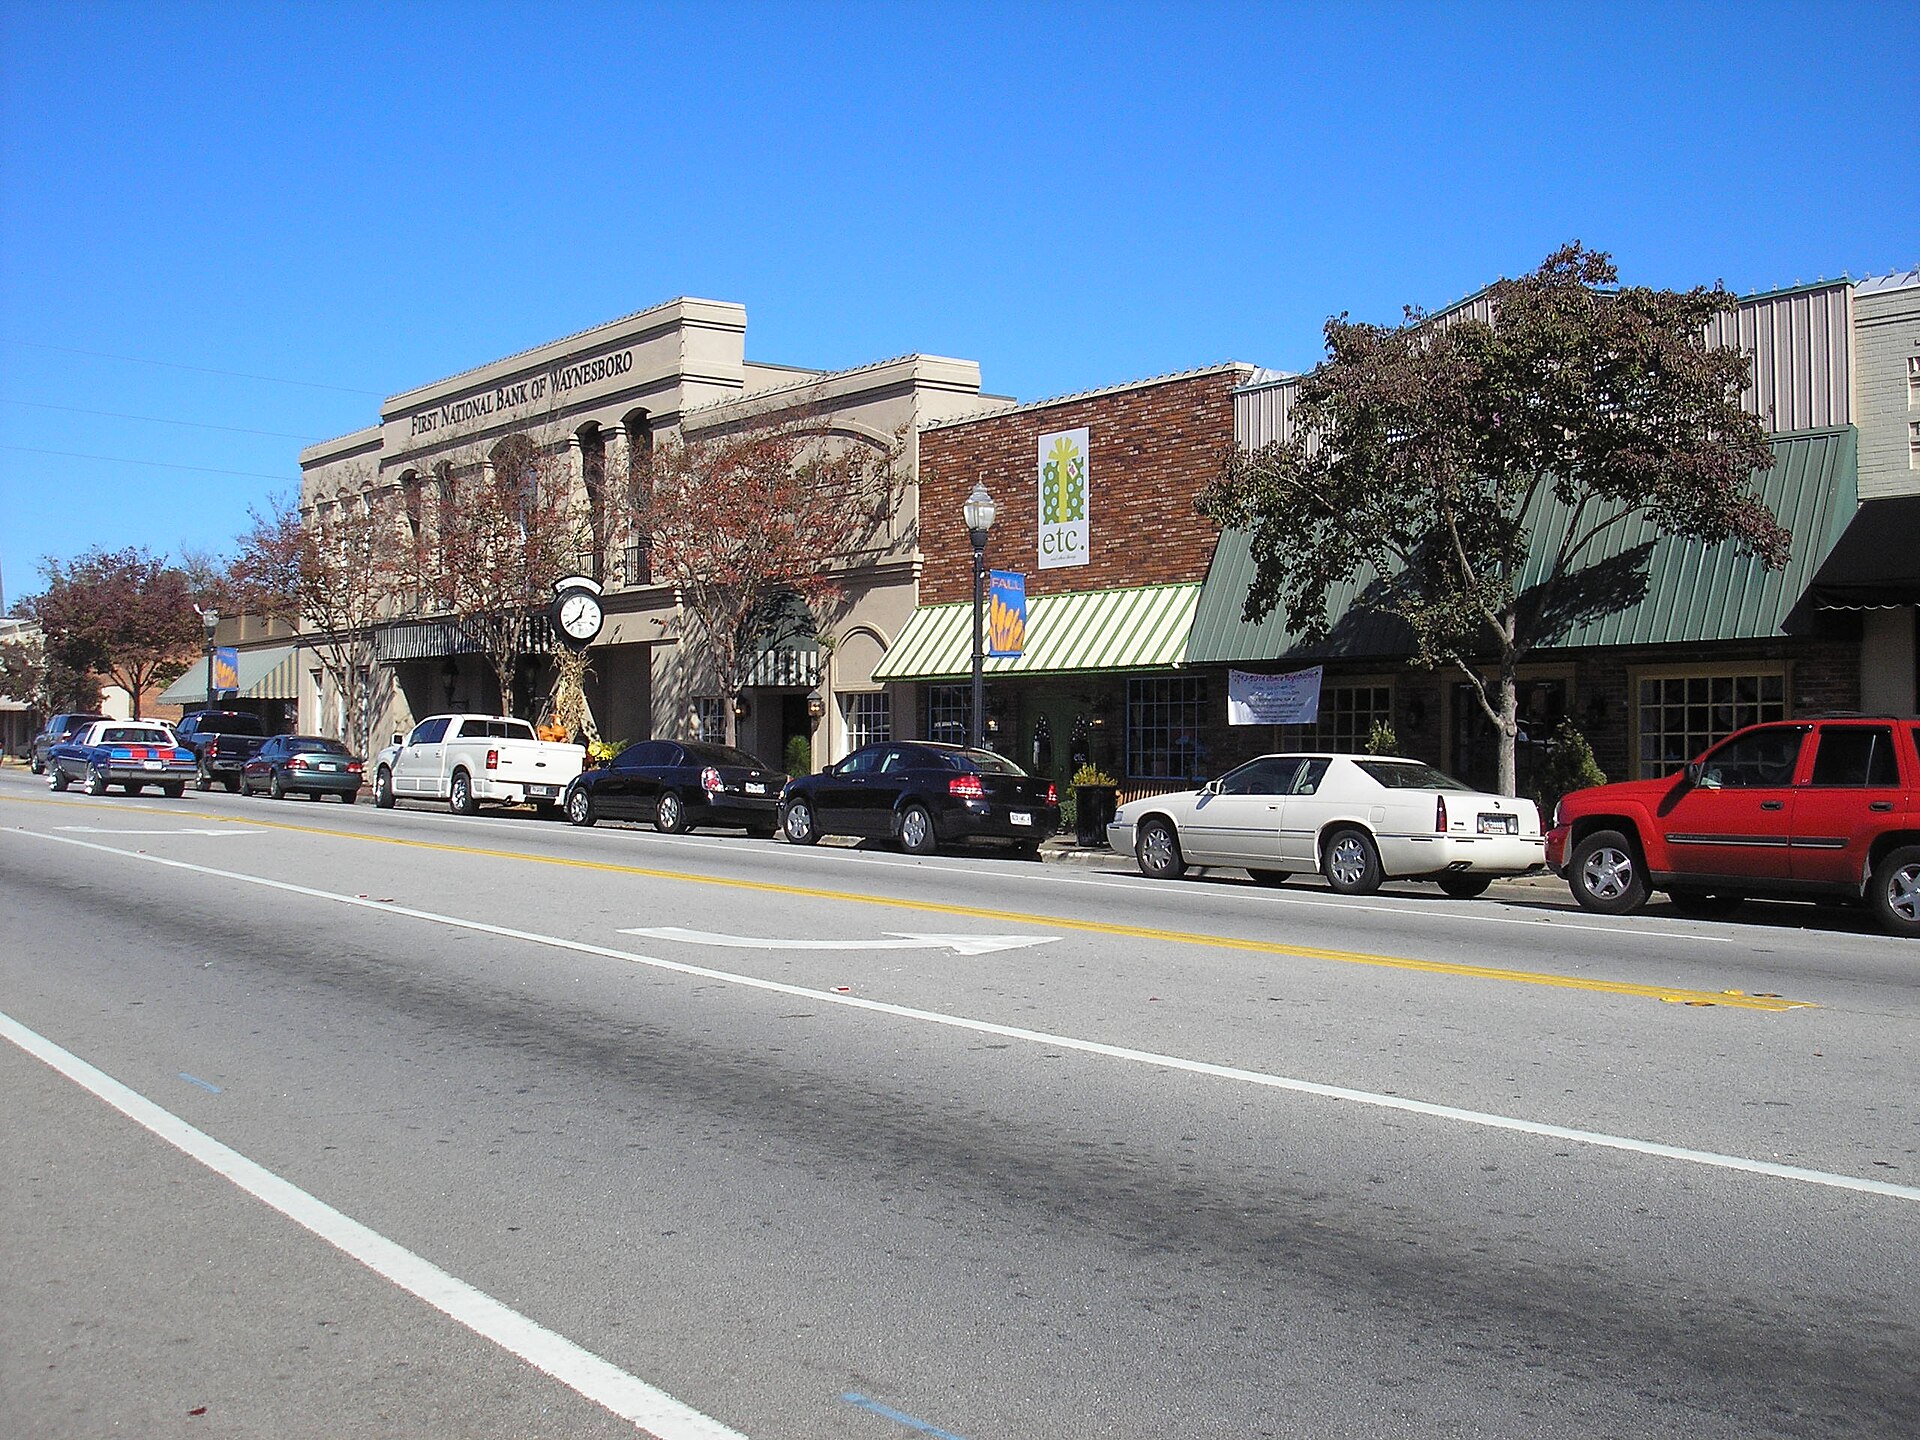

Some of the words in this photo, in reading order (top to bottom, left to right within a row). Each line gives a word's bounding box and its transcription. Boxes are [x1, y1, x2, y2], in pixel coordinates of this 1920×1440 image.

[411, 415, 438, 437] FIRST
[441, 394, 493, 428] NATIONAL
[496, 383, 529, 412] BANK
[531, 378, 547, 399] OF
[550, 351, 633, 394] WAYNESBORO
[1042, 526, 1084, 555] etc.
[991, 577, 1022, 590] FALL
